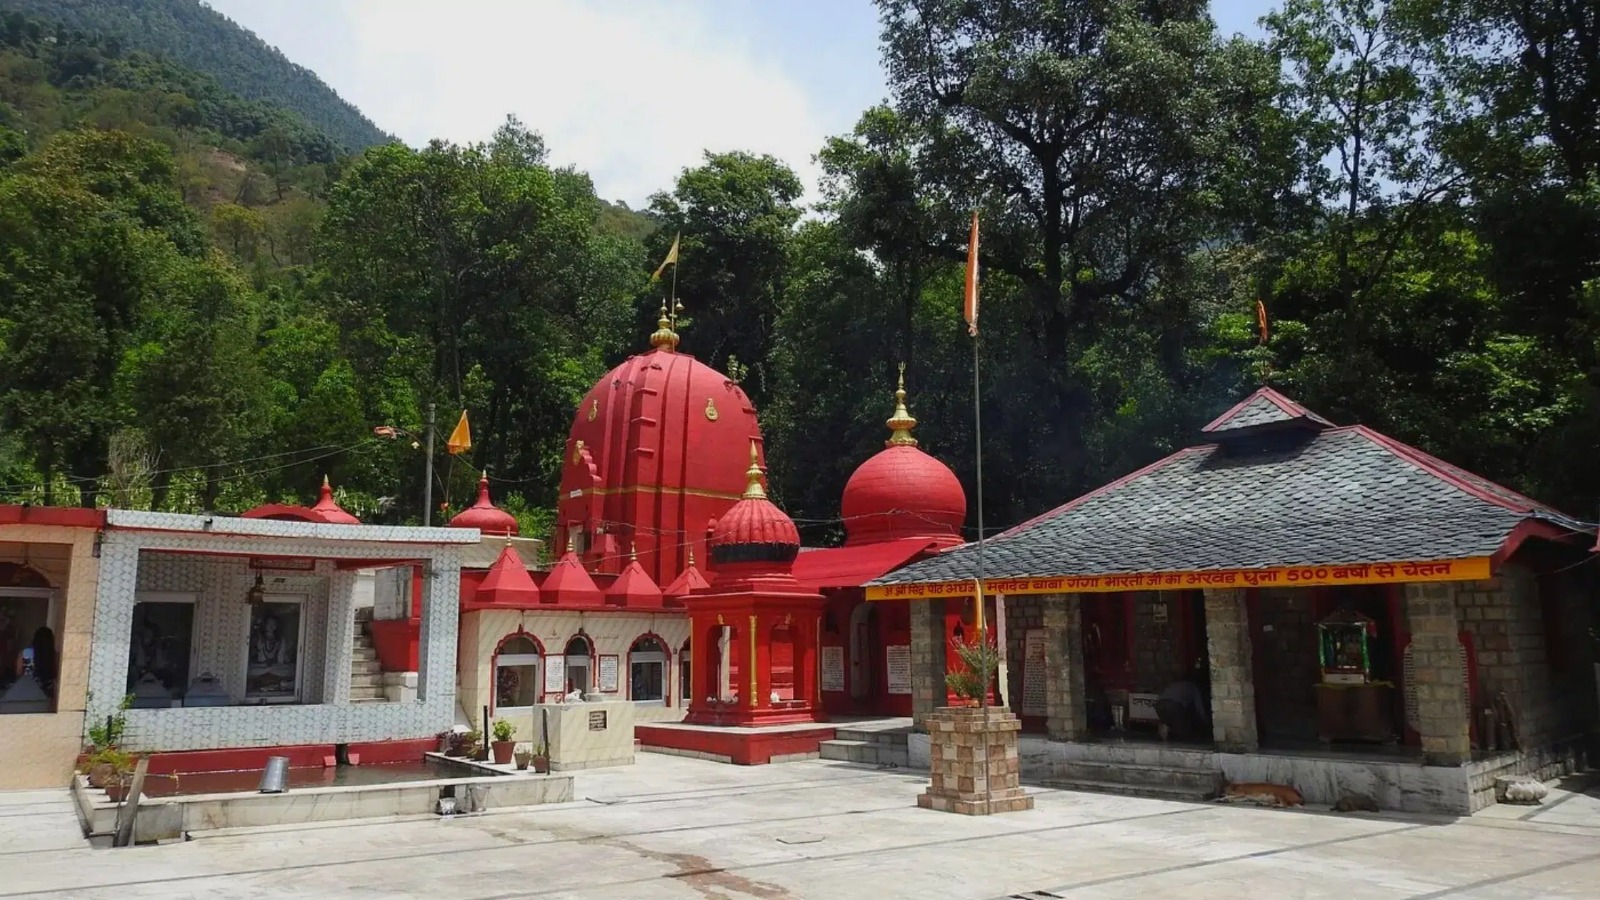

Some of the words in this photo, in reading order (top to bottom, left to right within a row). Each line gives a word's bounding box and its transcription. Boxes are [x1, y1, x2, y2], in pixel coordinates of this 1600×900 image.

[986, 579, 1029, 592] महादेव
[1032, 579, 1064, 590] बाबा
[1104, 573, 1144, 587] भारती
[1165, 574, 1182, 585] का
[1286, 568, 1328, 581] 500
[1374, 562, 1397, 578] से
[1401, 561, 1453, 577] चेतन
